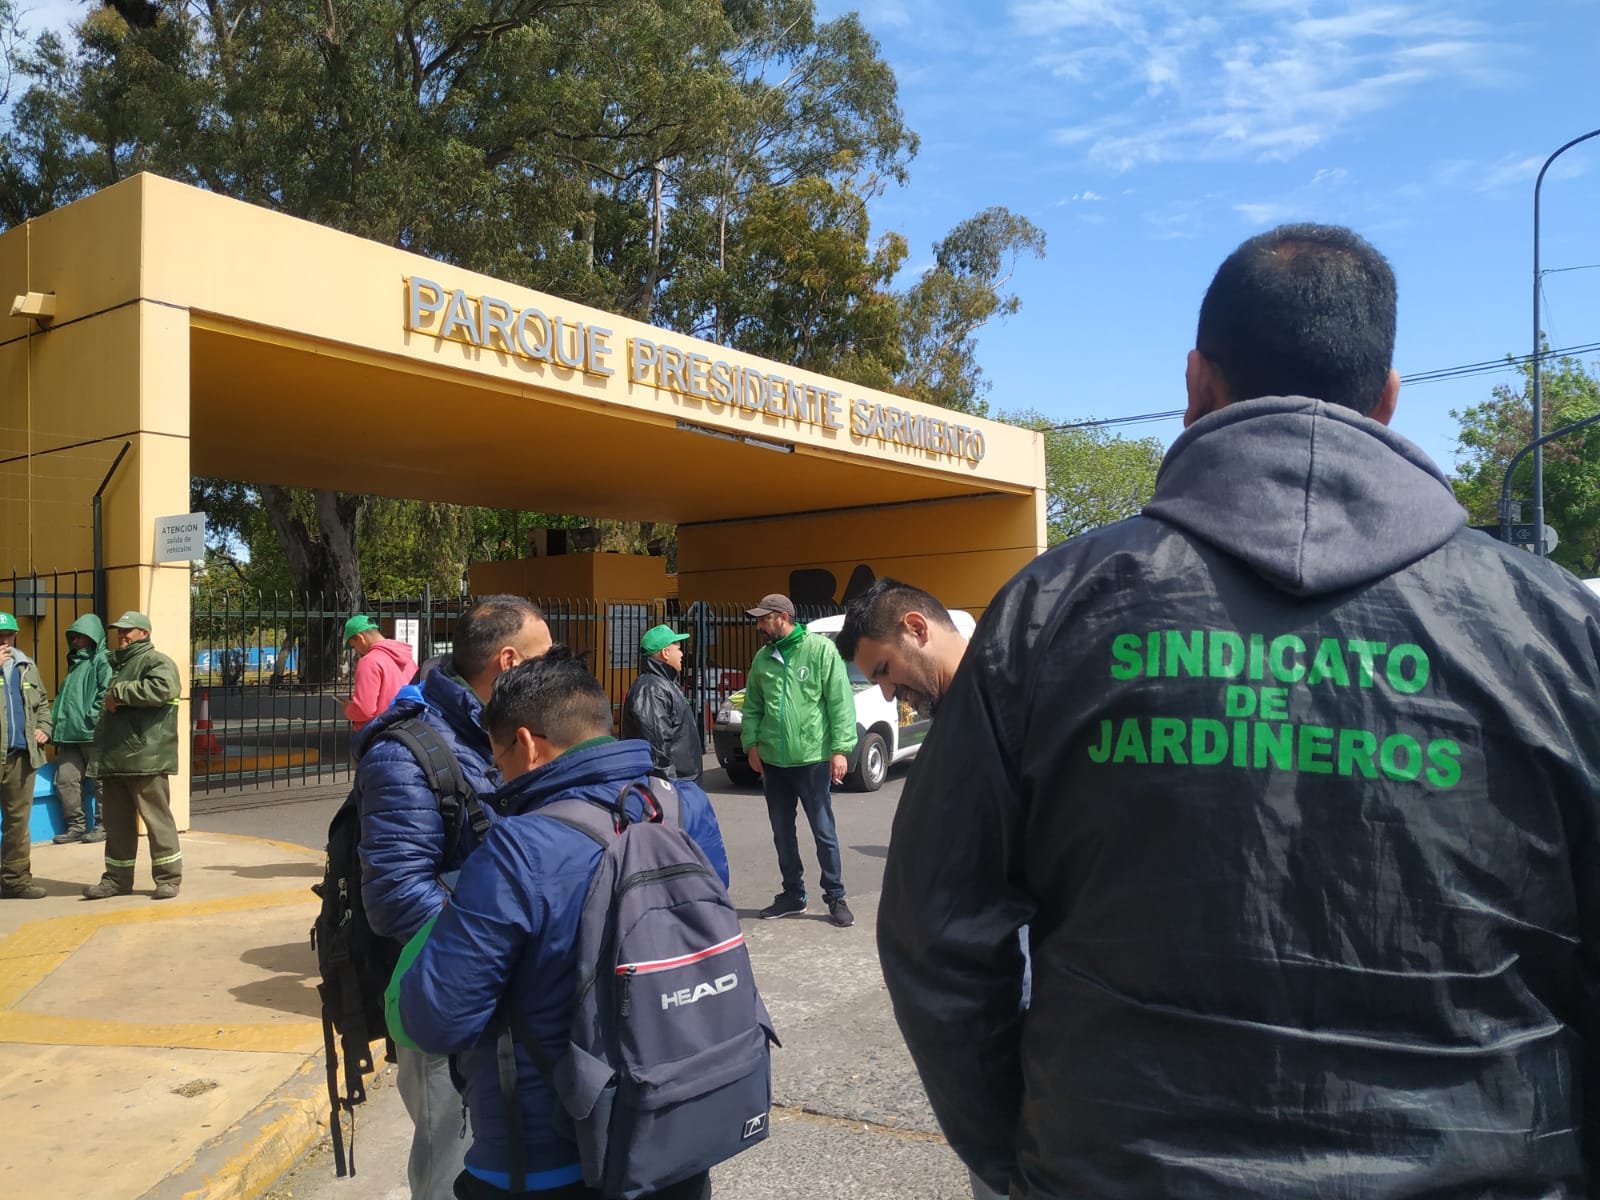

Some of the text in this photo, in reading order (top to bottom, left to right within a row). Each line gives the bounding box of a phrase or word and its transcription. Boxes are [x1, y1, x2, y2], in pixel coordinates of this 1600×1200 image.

[410, 276, 985, 461] PARQUE PRESIDENTE SARMIENTO
[1110, 630, 1430, 694] SINDICATO
[1225, 685, 1289, 720] DE
[1087, 717, 1462, 788] JARDINEROS
[661, 972, 738, 1010] HEAD
